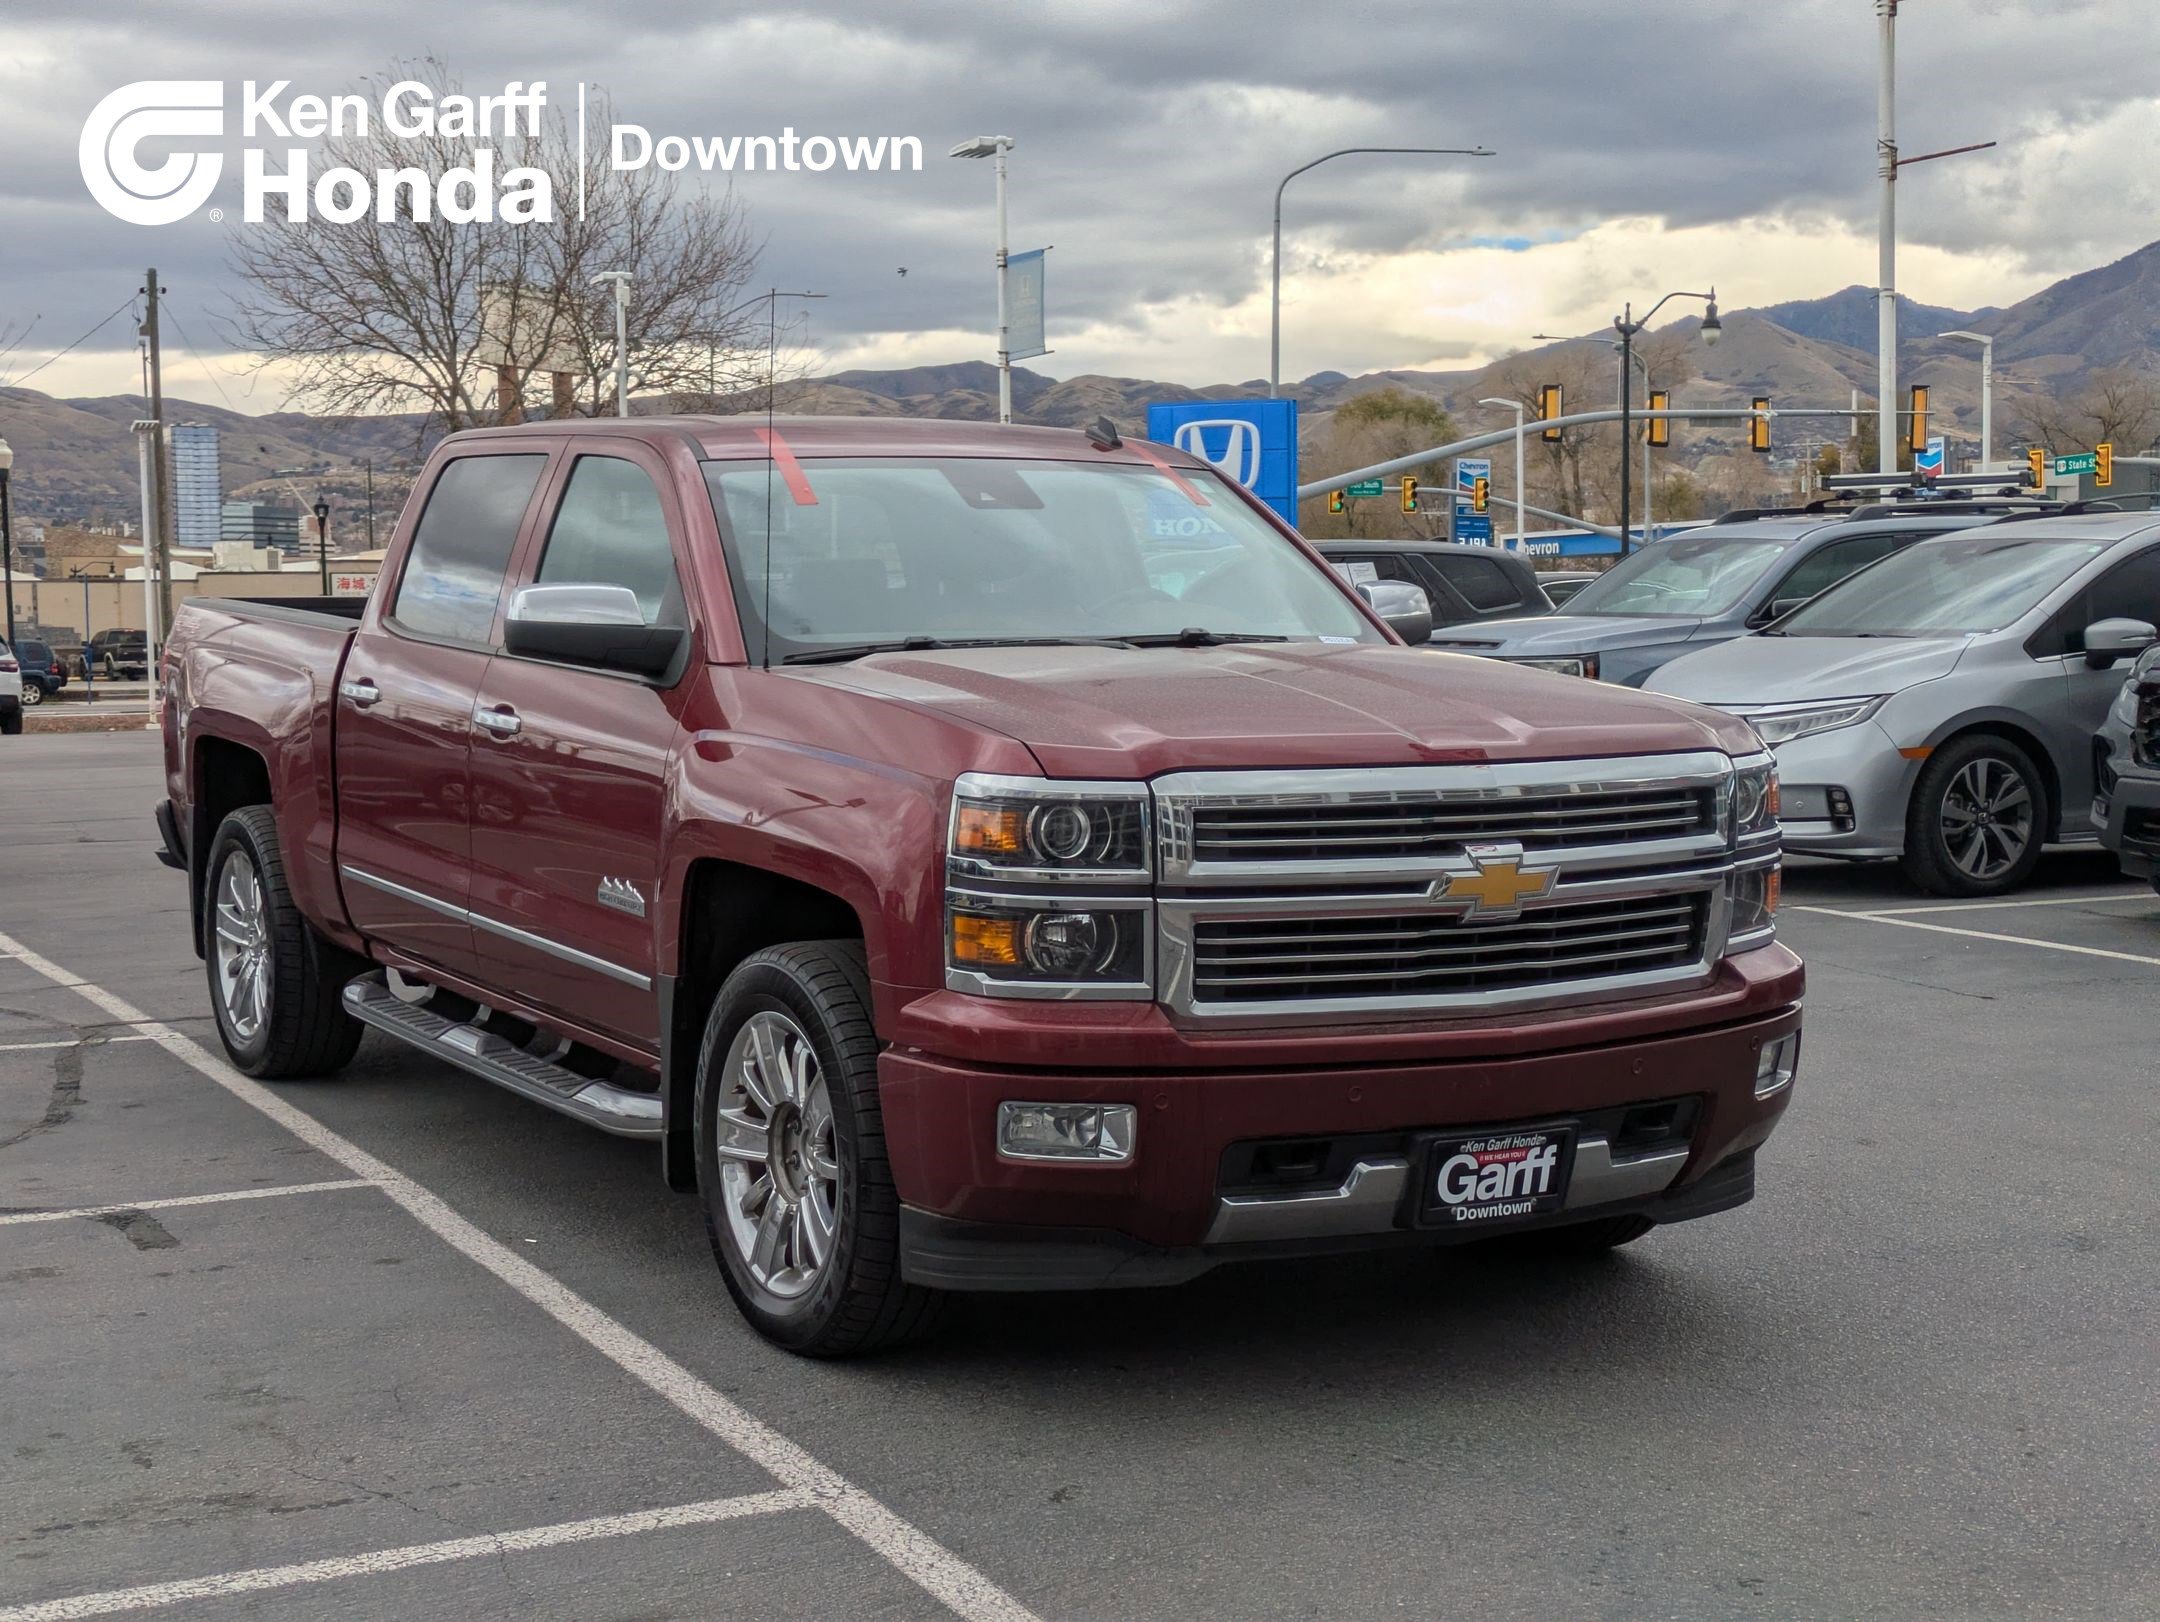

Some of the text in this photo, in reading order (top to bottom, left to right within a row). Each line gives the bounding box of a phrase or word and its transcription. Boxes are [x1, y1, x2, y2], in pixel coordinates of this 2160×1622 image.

[1459, 462, 1489, 470] Chevron
[2068, 459, 2087, 470] State
[1465, 1133, 1543, 1153] Ken Garff Honda
[1494, 1152, 1510, 1160] HEAR
[1510, 1151, 1522, 1159] YOU
[1437, 1144, 1558, 1205] Garff
[1456, 1200, 1533, 1221] Downtown
